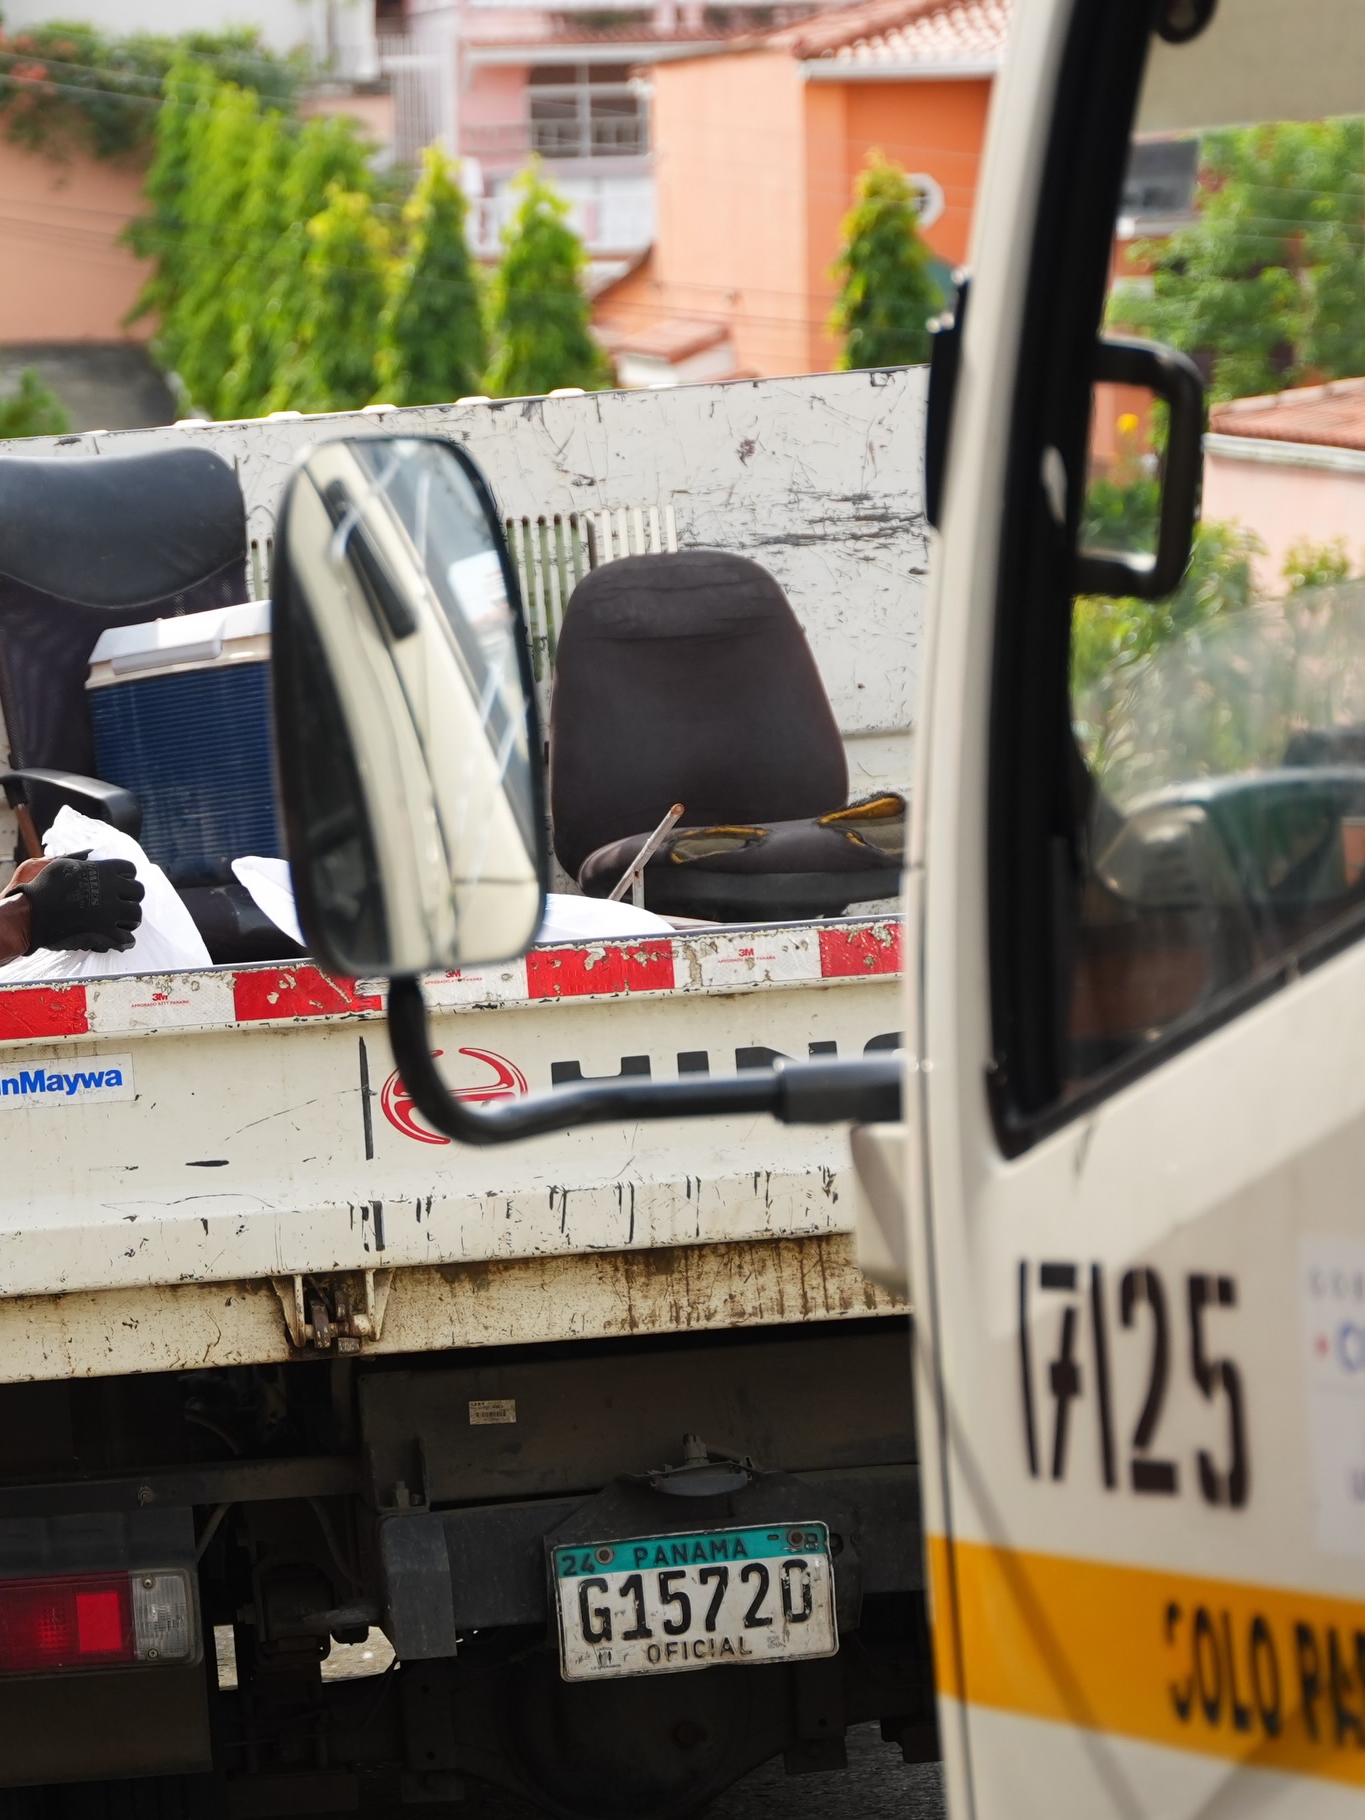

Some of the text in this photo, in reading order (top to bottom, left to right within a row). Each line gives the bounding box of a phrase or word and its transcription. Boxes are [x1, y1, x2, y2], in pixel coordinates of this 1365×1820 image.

[738, 948, 754, 957] 3M
[445, 969, 461, 978] 3M
[152, 993, 169, 1001] 3M
[562, 1554, 595, 1576] 24
[634, 1537, 749, 1567] PANAMA
[647, 1636, 753, 1664] OFICIAL
